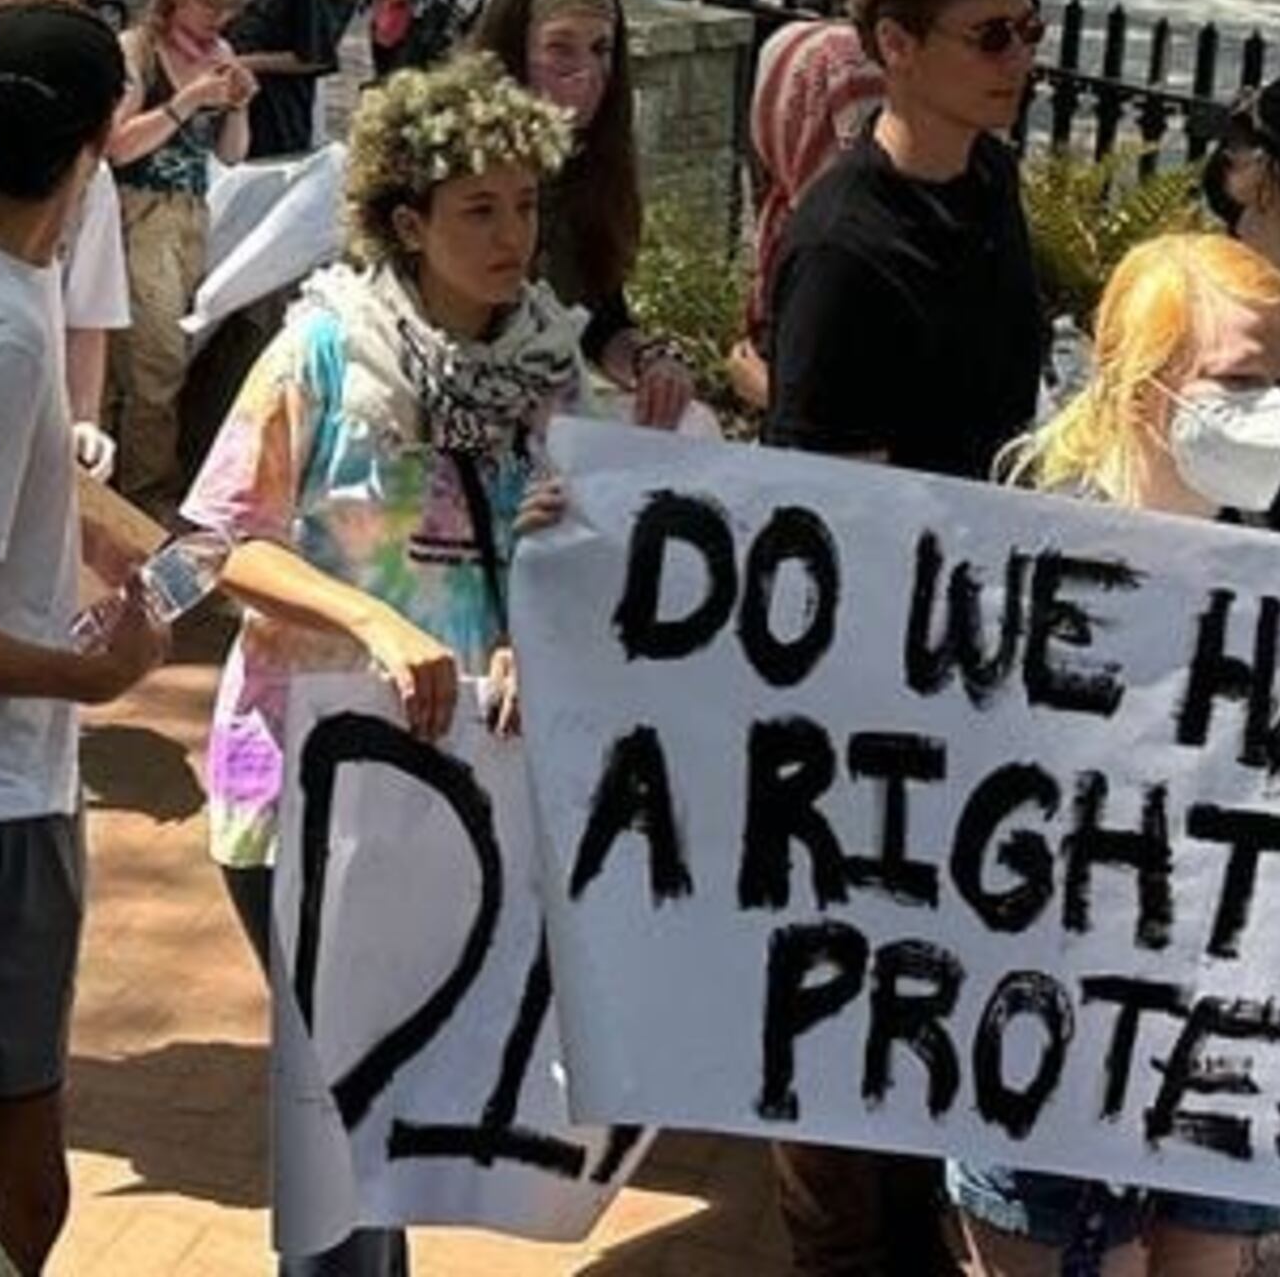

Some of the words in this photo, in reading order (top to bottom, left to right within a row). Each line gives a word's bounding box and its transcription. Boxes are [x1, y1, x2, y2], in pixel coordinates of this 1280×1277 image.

[611, 487, 841, 689] DO
[903, 528, 1140, 718] WE
[567, 724, 694, 906] A
